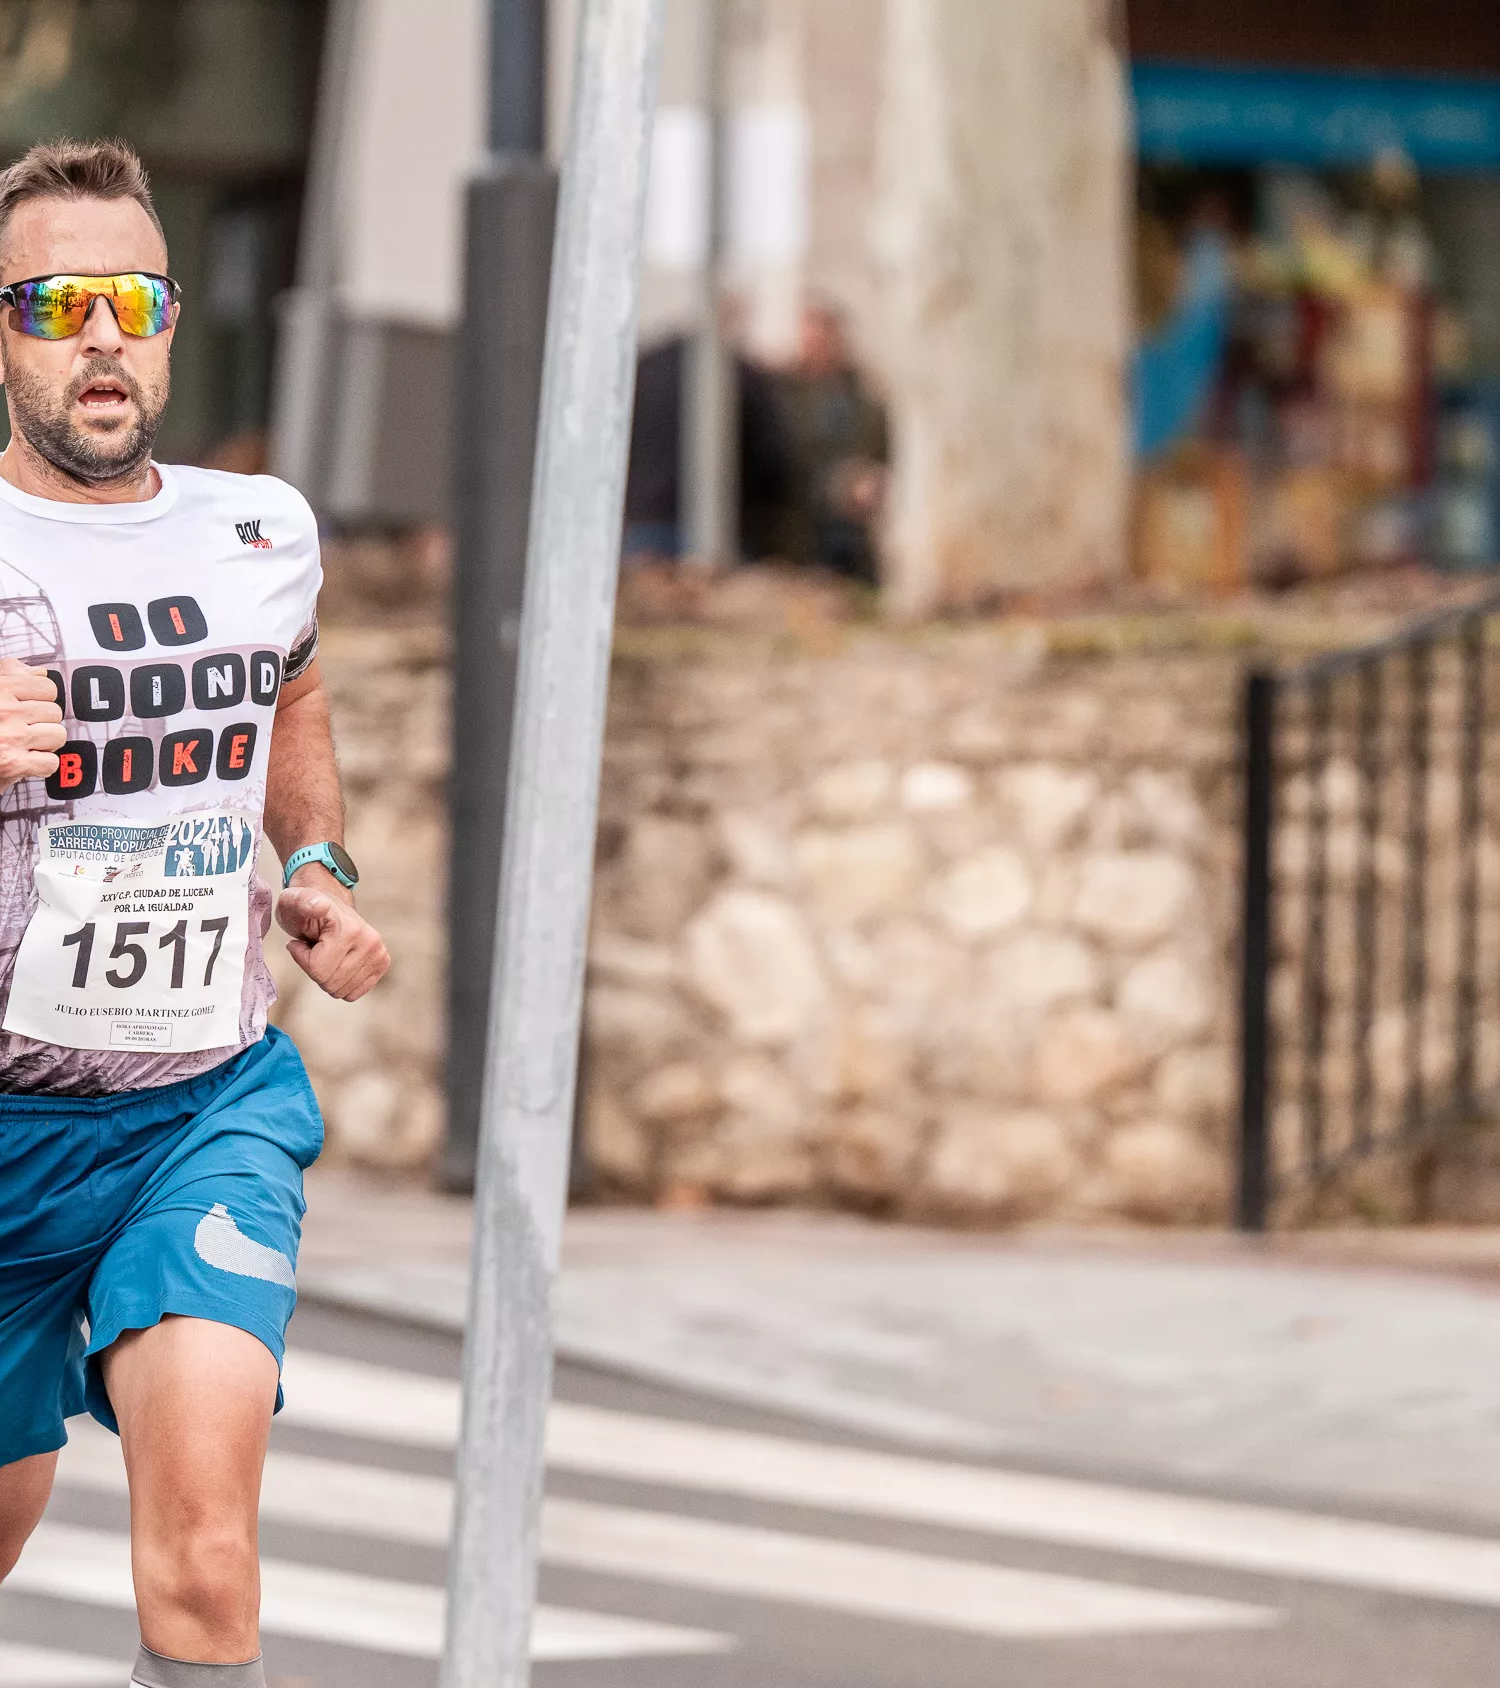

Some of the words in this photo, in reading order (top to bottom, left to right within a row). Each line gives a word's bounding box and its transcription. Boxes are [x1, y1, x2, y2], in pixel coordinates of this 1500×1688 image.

[89, 662, 276, 710] LIND
[59, 734, 249, 788] BIKE
[48, 826, 98, 838] CIRCUITO
[101, 828, 158, 840] PROVINCIAL
[159, 826, 169, 837] DE
[167, 817, 222, 846] 2024
[49, 837, 110, 851] CARRERAS
[113, 837, 166, 852] POPULARES
[114, 854, 125, 863] DE
[100, 891, 119, 902] XXV
[133, 889, 167, 898] CIUDAD
[169, 888, 181, 897] DE
[183, 887, 214, 897] LUCENA
[114, 904, 131, 913] POR
[133, 903, 145, 912] LA
[148, 902, 194, 912] IGUALDAD
[62, 916, 229, 989] 1517
[54, 1003, 88, 1016] JULIO
[89, 1007, 133, 1017] EUSEBIO
[135, 1007, 190, 1018] MARTINEZ
[191, 1005, 216, 1017] GOMEZ
